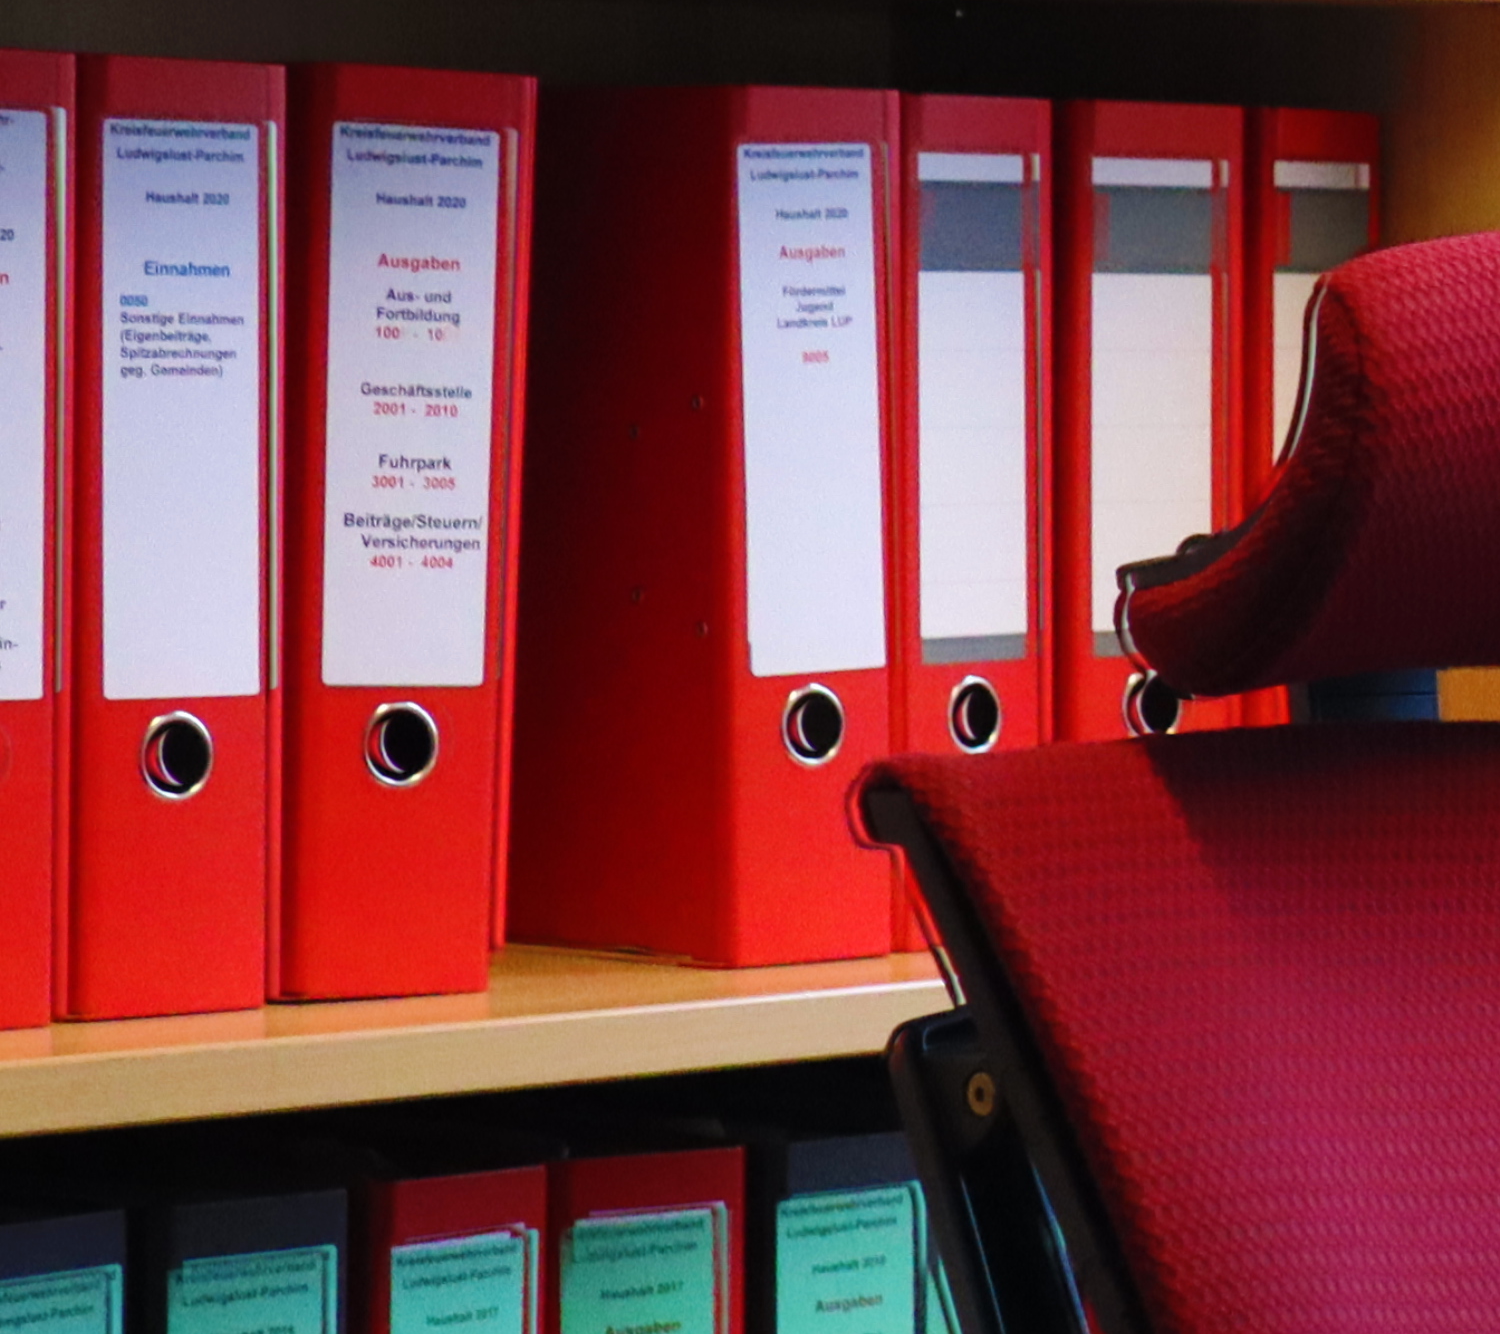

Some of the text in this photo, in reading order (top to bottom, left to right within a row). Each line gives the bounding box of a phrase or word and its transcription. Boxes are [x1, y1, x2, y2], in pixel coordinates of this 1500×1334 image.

[146, 191, 199, 206] Haushalt
[376, 192, 467, 209] Haushalt 2020
[378, 253, 461, 273] Ausgaben
[780, 246, 846, 263] Ausgaben
[144, 260, 230, 278] Einnahmen
[386, 288, 452, 304] Aus- und
[120, 312, 244, 327] Sonstige Einnahmen
[376, 306, 461, 327] Fortbildung
[120, 347, 237, 363] Spitzabrechnungen
[151, 364, 223, 378] Gemeinden)
[361, 382, 473, 400] Geschäftsstelle
[373, 402, 458, 418] 2001 2010
[379, 454, 452, 472] Fuhrpark
[372, 476, 404, 489] 3001
[344, 513, 482, 532] Beiträge/Steuern/
[361, 533, 480, 553] Versicherungen
[370, 554, 453, 569] 4001 4004
[815, 1293, 884, 1314] Ausgaben
